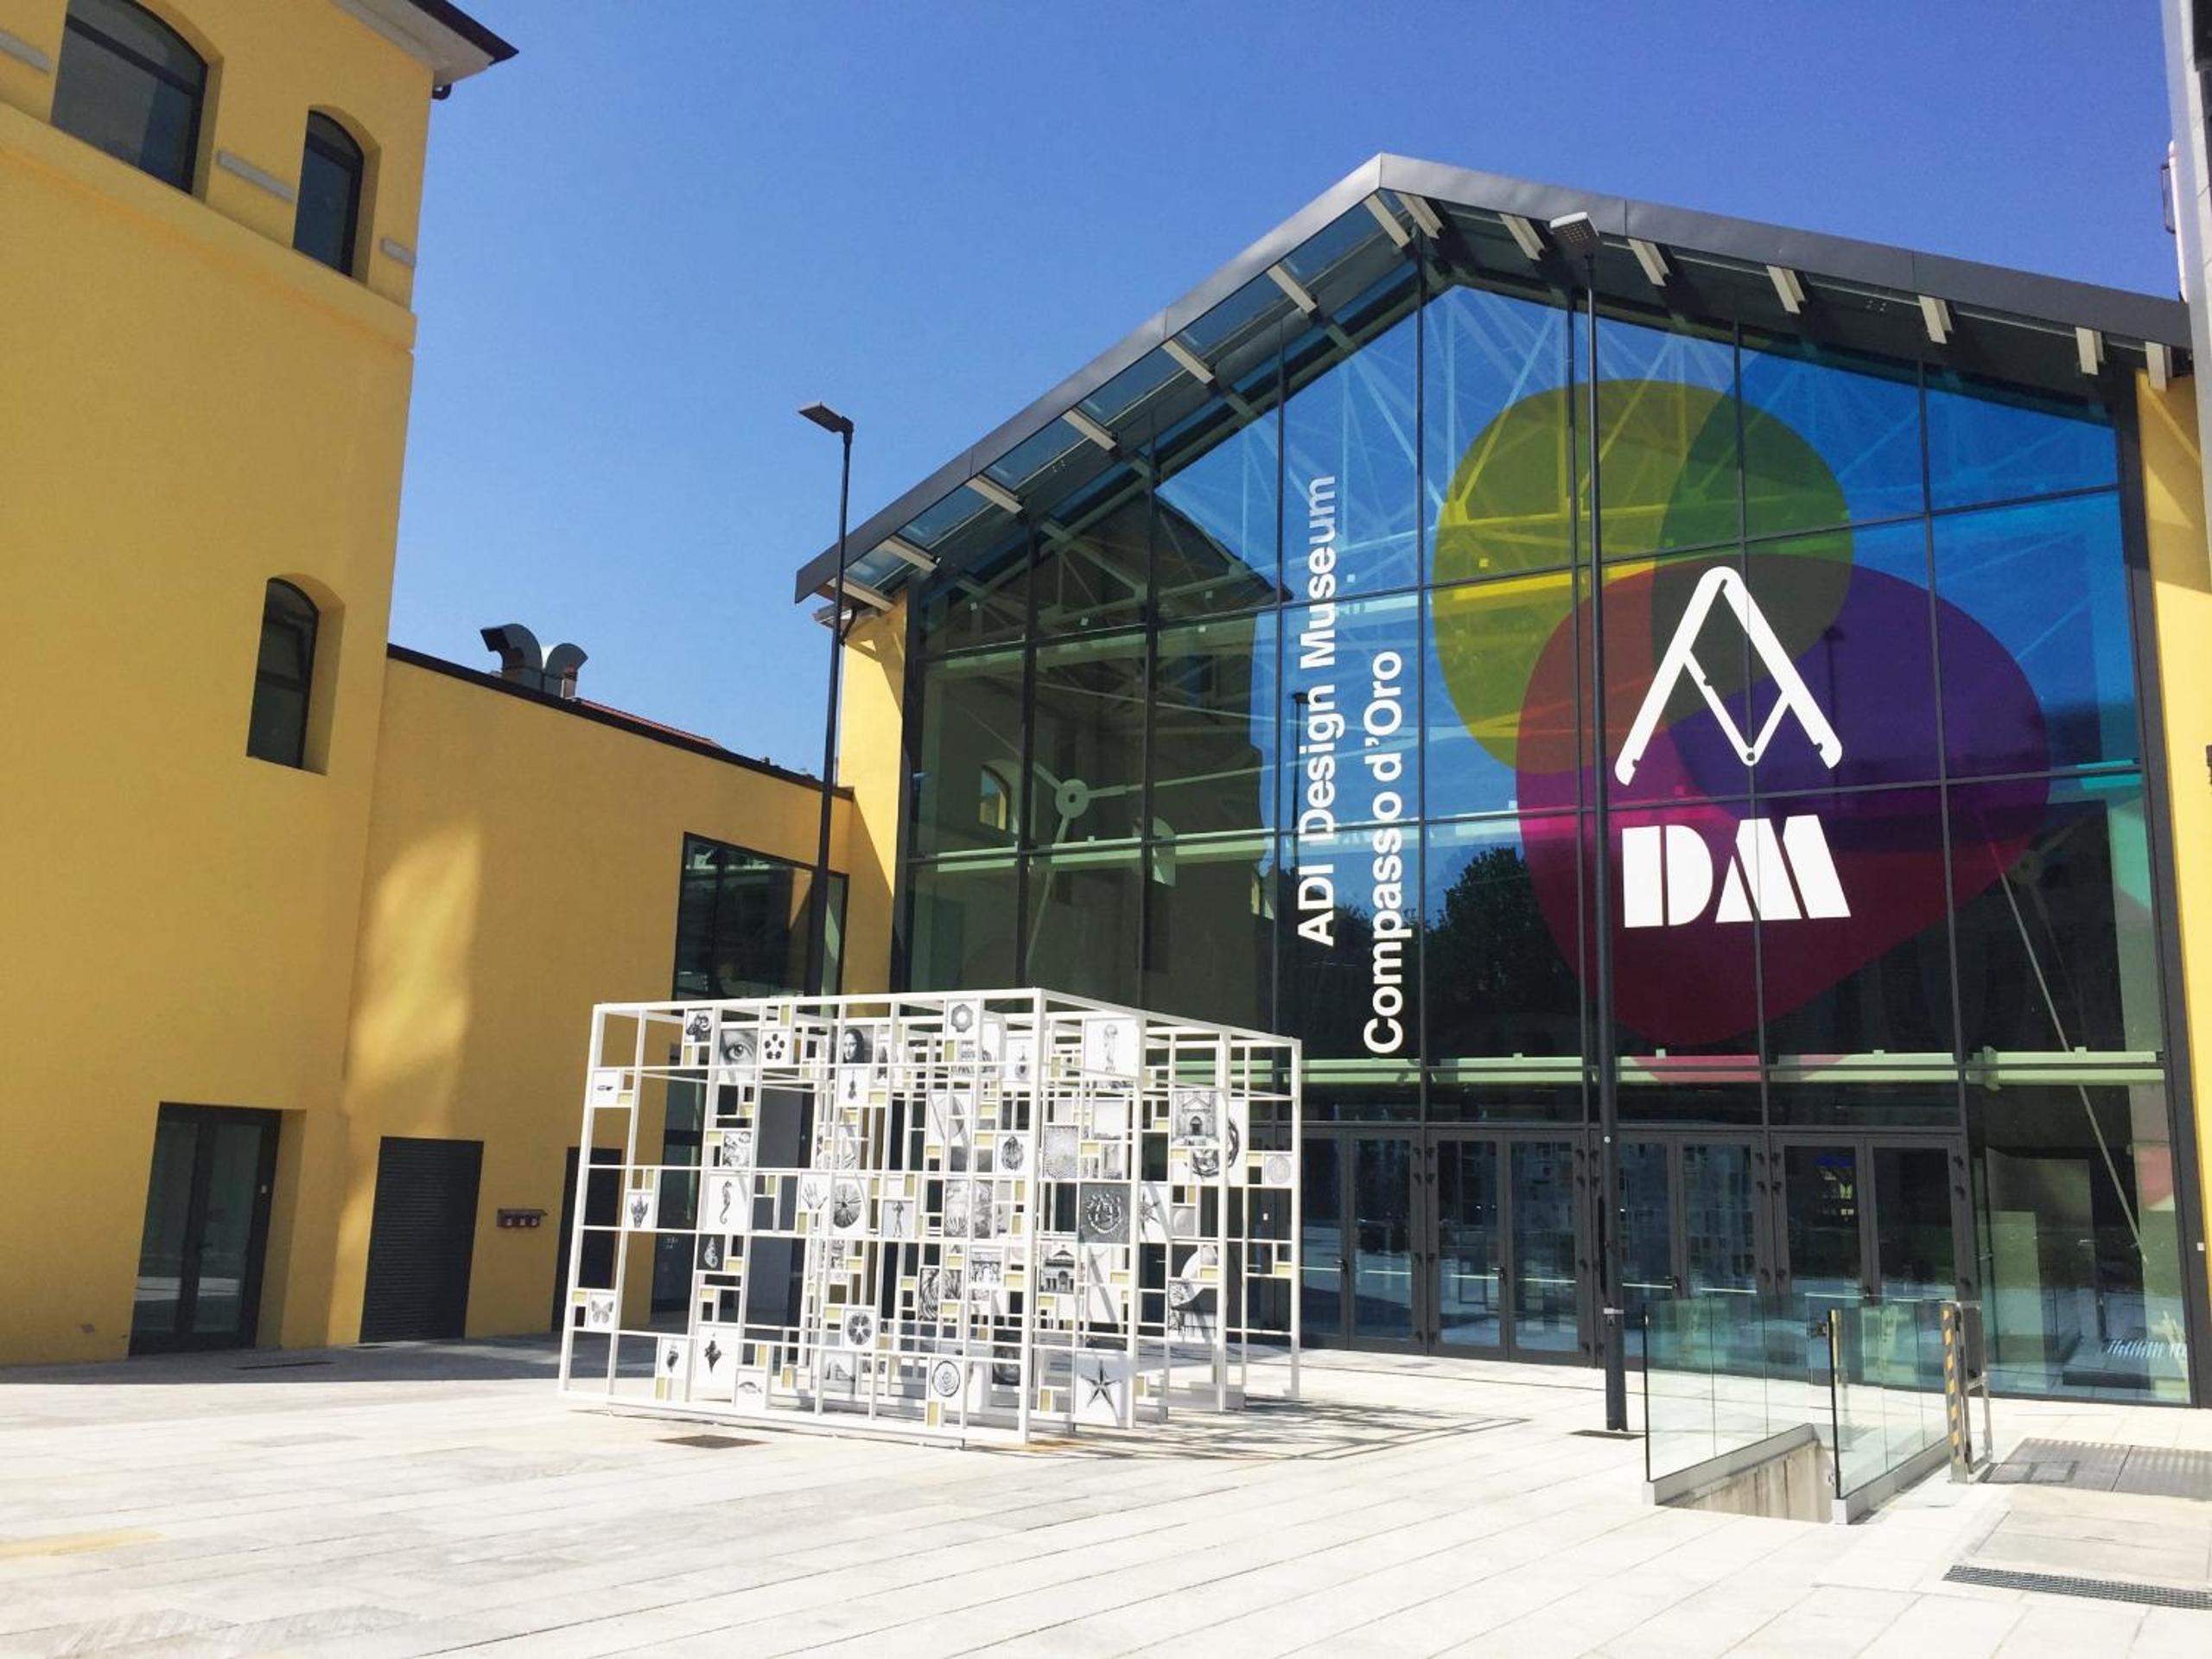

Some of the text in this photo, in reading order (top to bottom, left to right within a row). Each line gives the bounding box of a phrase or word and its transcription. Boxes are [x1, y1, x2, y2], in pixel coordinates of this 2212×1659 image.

[1297, 475, 1344, 946] ADI Design Museum
[1363, 651, 1412, 1053] Compasso d'Oro
